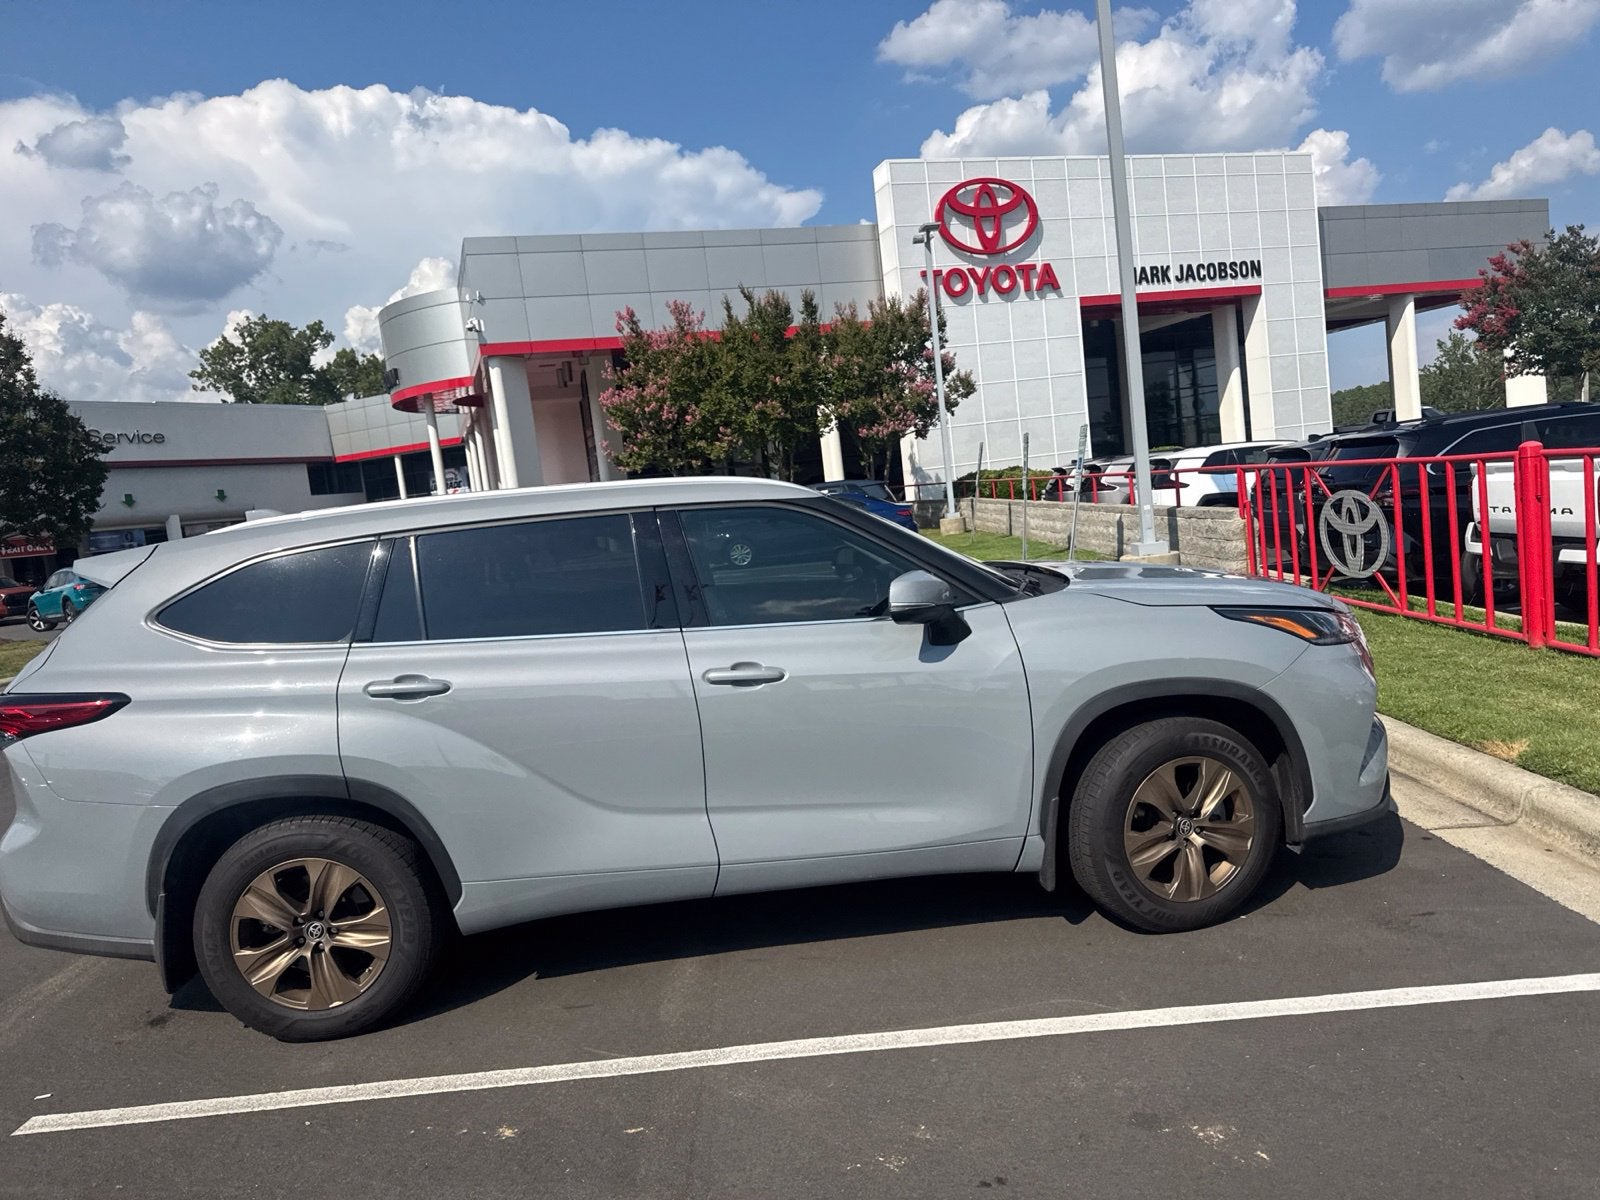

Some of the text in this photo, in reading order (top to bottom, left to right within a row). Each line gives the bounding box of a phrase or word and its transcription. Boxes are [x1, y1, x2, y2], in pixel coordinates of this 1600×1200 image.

[920, 263, 1061, 298] TOYOTA
[1175, 259, 1262, 283] JACOBSON
[87, 429, 165, 444] Service
[1489, 506, 1573, 515] TAA
